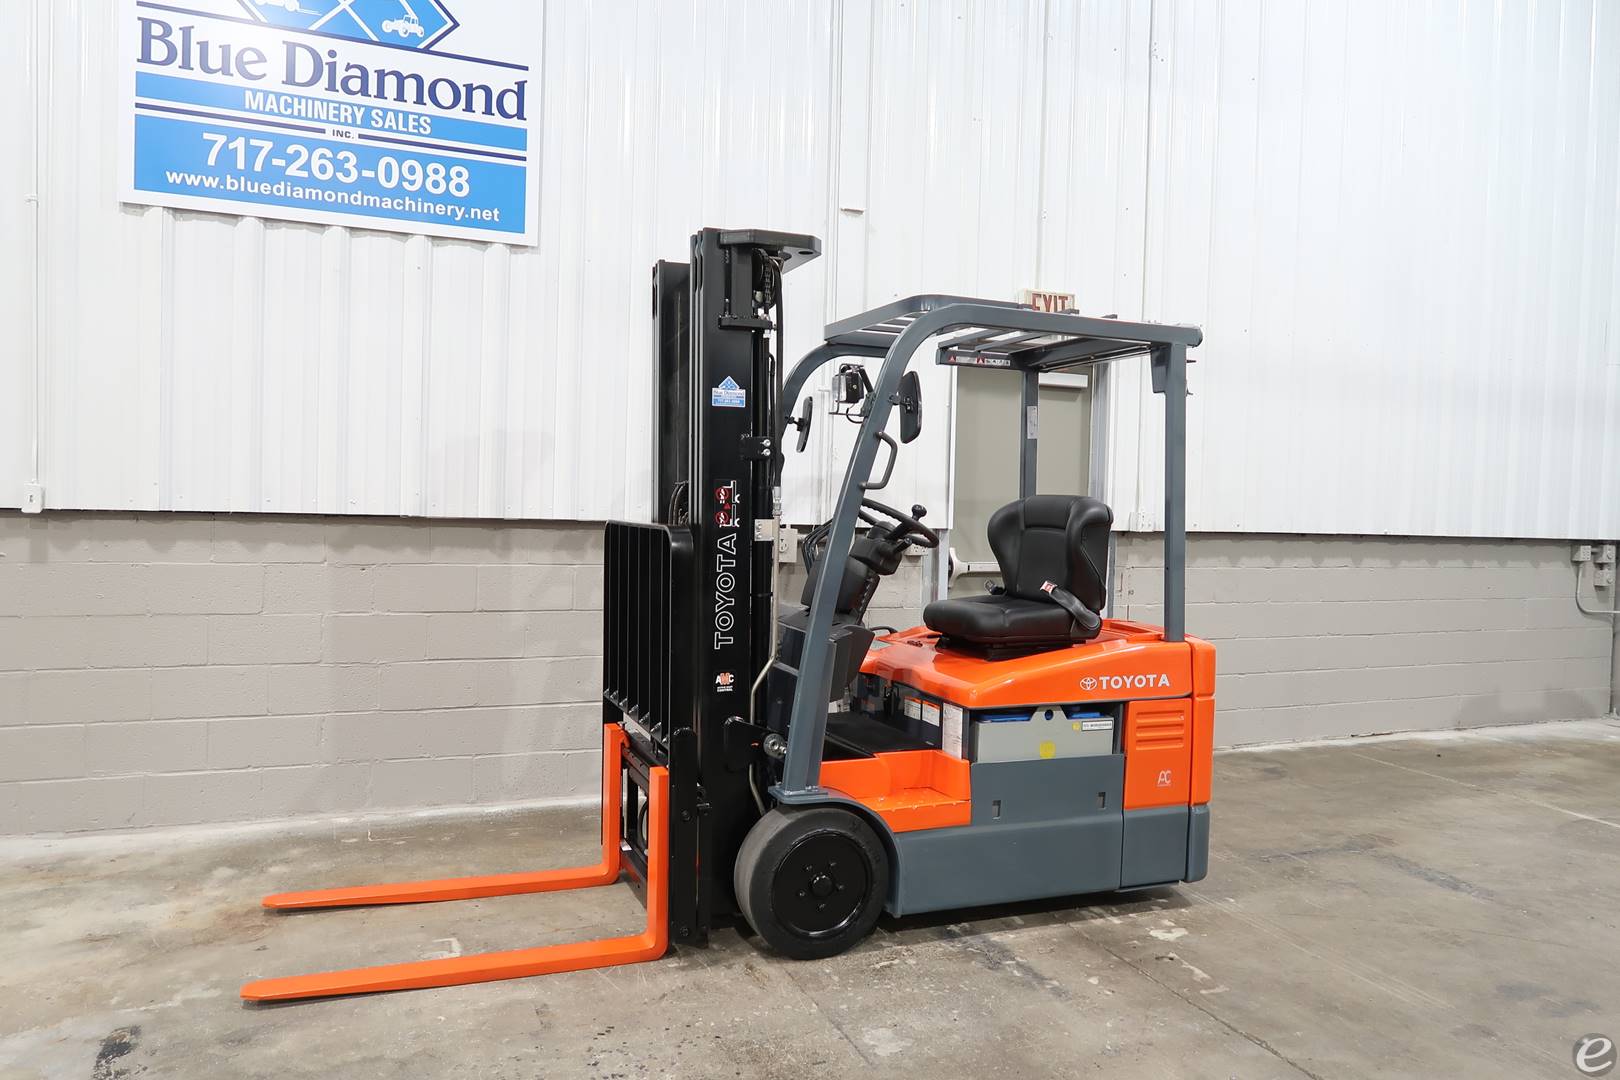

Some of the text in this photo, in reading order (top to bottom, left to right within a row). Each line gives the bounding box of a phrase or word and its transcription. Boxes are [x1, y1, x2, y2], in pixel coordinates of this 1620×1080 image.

[137, 17, 528, 121] Blue Diamond
[244, 90, 432, 135] MACHINERY SALES
[332, 128, 355, 140] INC.
[202, 132, 470, 198] 717-263-0988
[166, 169, 501, 222] www.bluediamondmachinery.net
[714, 533, 737, 650] TOYOTA
[1099, 674, 1170, 690] TOYOTA
[1157, 770, 1171, 785] AC
